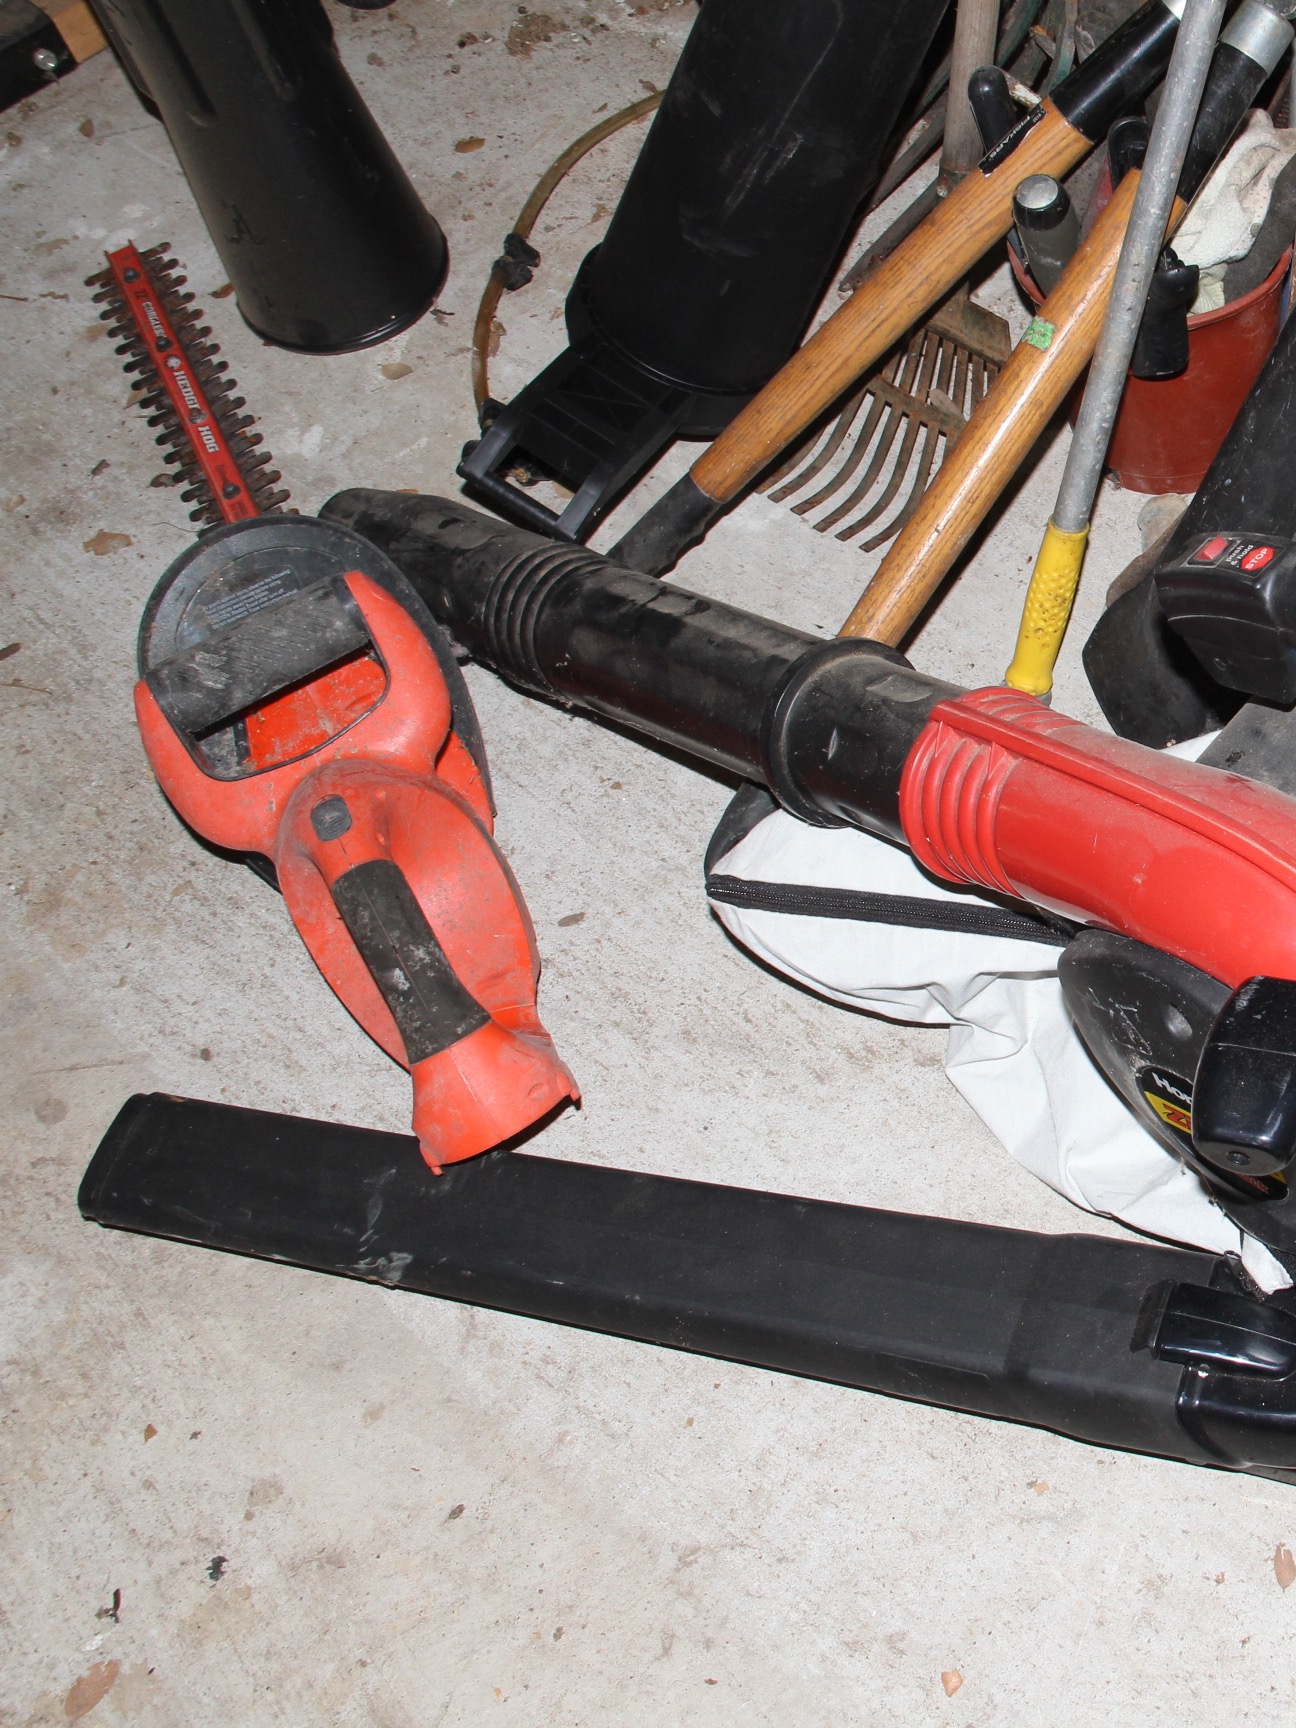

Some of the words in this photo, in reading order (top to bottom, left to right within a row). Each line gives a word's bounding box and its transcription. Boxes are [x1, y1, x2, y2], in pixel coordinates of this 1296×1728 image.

[197, 425, 220, 454] HOG
[1226, 545, 1244, 562] push
[1236, 544, 1254, 559] hold
[1245, 548, 1267, 570] STOP
